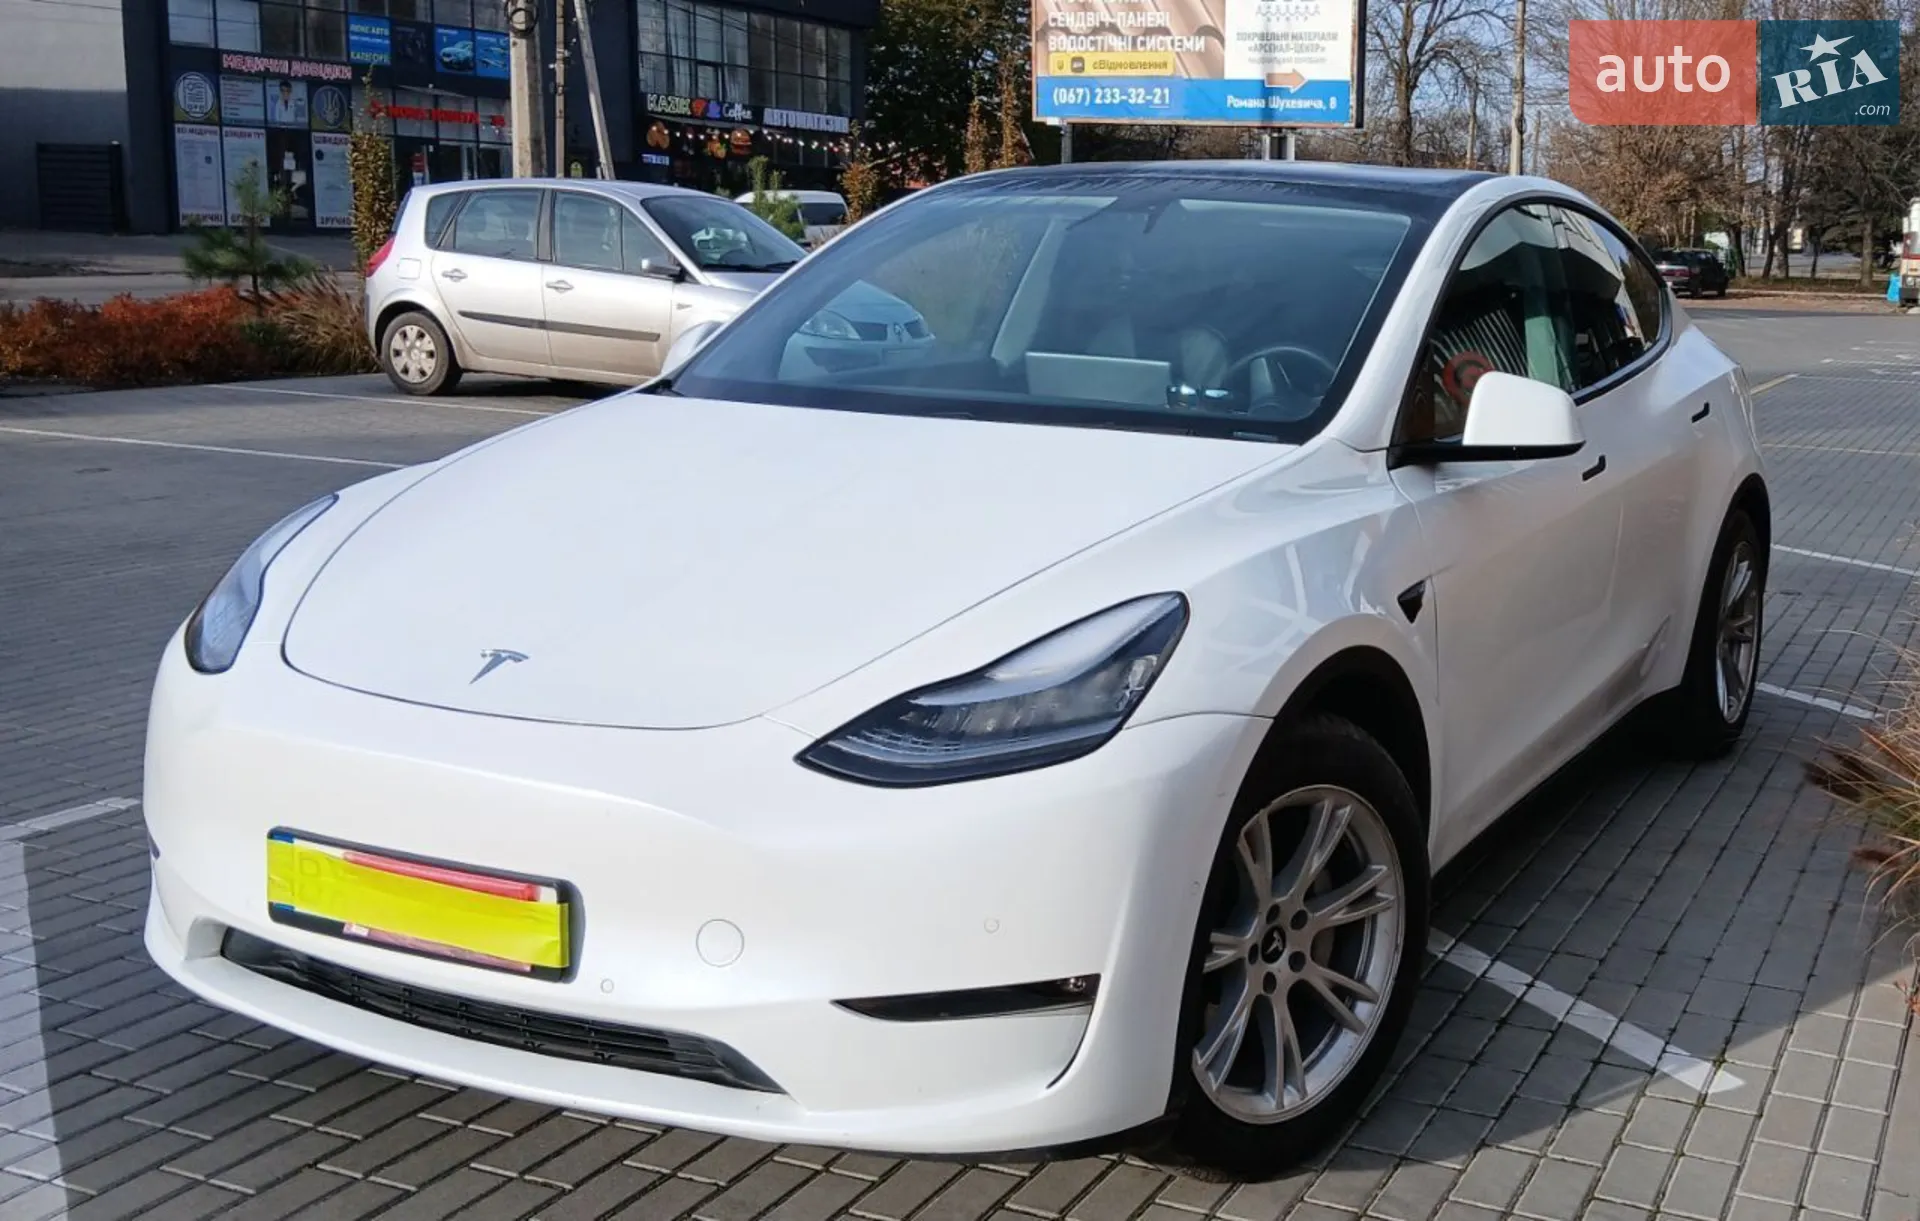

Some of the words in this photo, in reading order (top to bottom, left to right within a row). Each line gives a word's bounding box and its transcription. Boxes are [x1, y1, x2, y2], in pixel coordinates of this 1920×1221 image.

[1048, 35, 1132, 53] ВОДОСТІЧНІ
[1136, 35, 1206, 53] СИСТЕМИ
[222, 53, 289, 75] МЕДИЧНІ
[290, 60, 352, 81] ДОВІДКИ
[1053, 87, 1090, 106] (067)
[1094, 87, 1170, 105] 233-32-21
[1226, 95, 1266, 108] Романа
[1268, 95, 1326, 111] Шухевича,
[722, 103, 752, 121] Coffee
